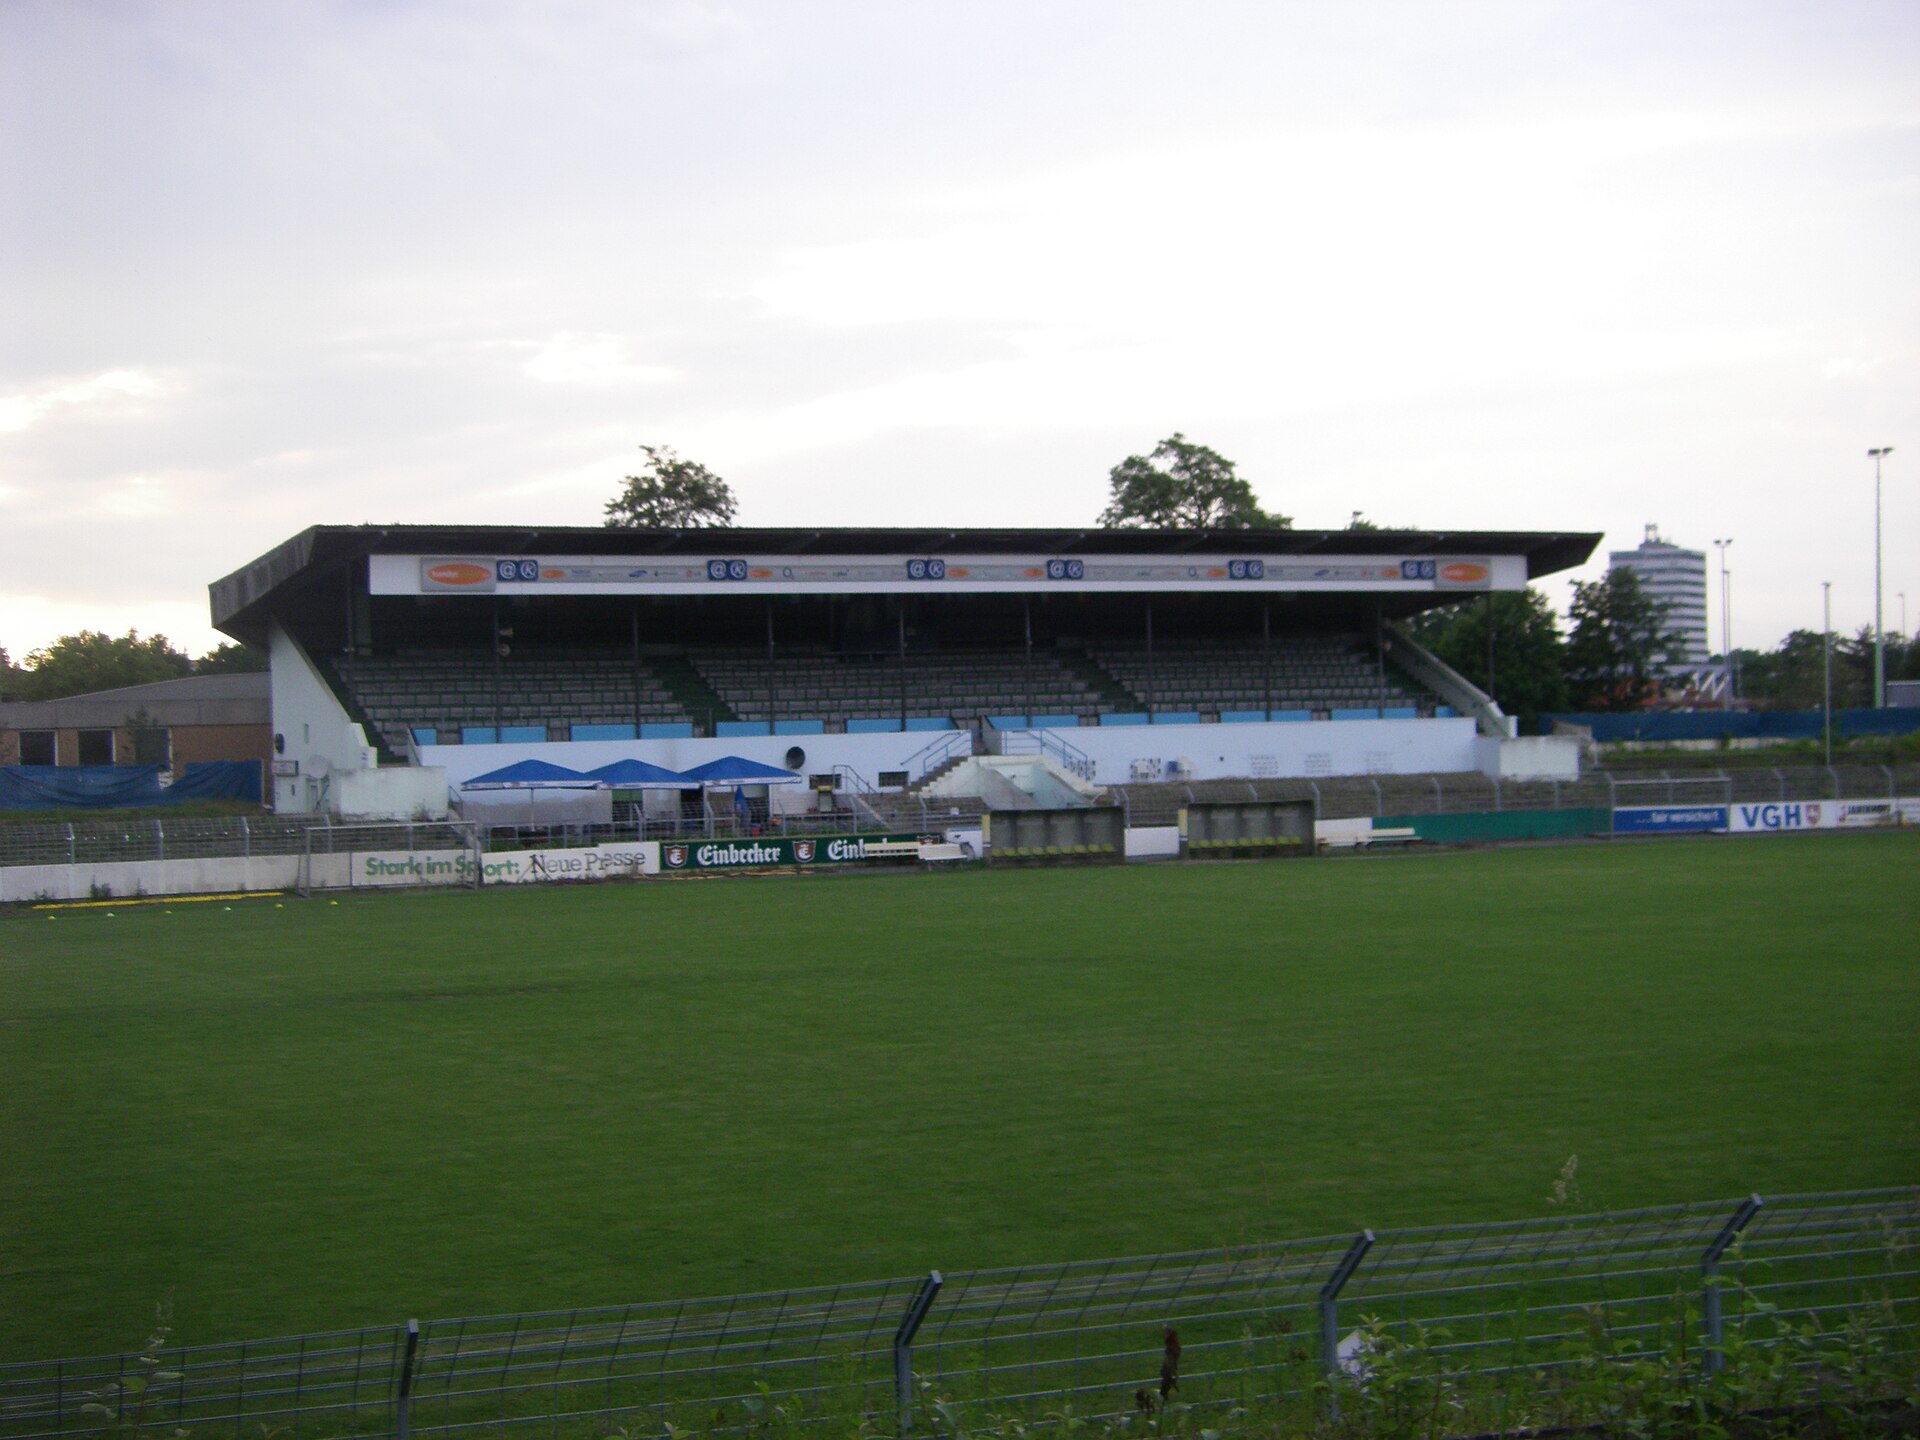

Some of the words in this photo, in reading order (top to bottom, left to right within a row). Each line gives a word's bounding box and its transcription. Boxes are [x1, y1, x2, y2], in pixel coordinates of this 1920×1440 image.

[1740, 805, 1801, 828] VGH
[529, 854, 583, 874] Neue
[584, 851, 646, 872] Presse
[696, 842, 781, 866] Einbecker
[366, 856, 422, 876] Stark
[426, 856, 453, 874] im
